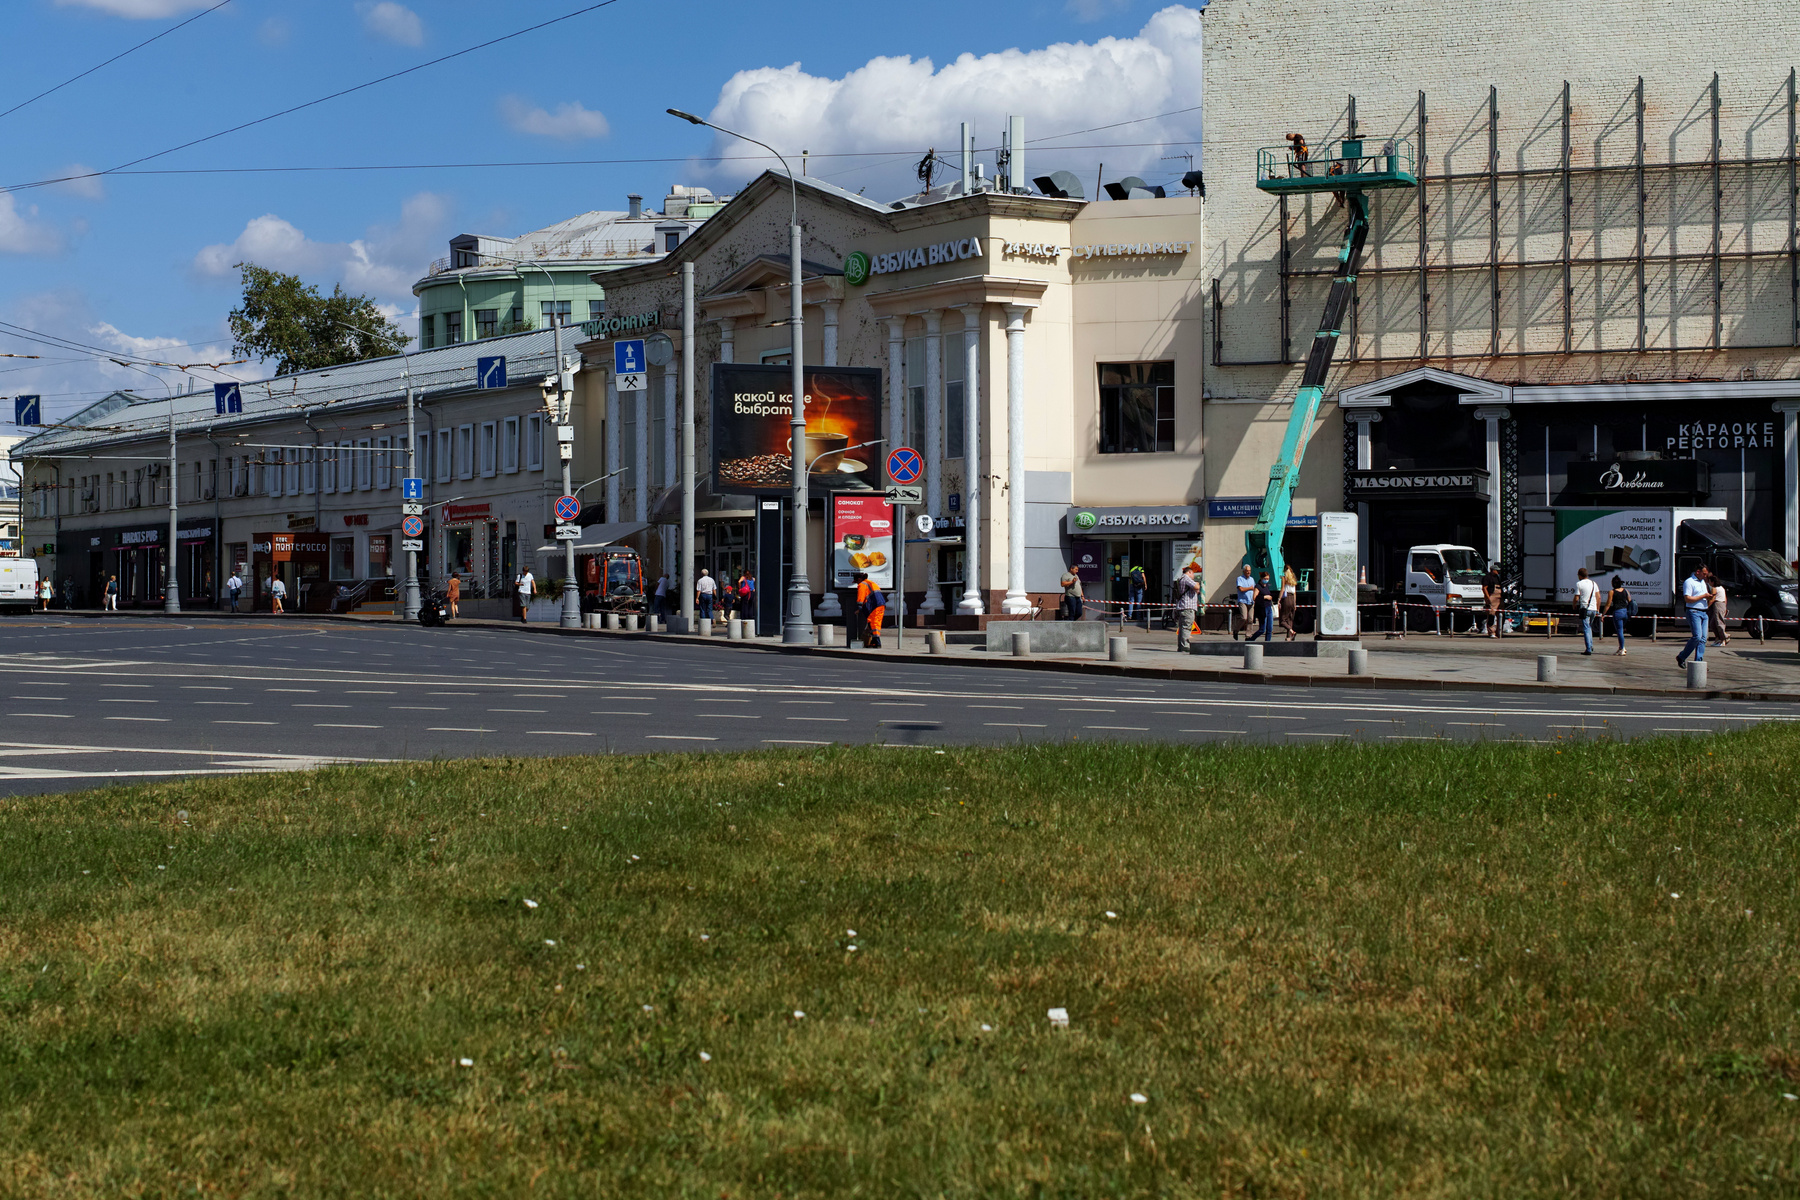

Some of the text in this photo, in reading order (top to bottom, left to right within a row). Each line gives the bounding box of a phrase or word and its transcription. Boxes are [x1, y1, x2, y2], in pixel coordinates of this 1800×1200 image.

[869, 237, 983, 276] АЗБУКА ВКУСА
[1005, 241, 1062, 257] 24 ЧАСА
[1072, 241, 1195, 259] СУПЕРМАРКЕТ
[580, 315, 638, 336] ЧАЙХОНА
[734, 391, 812, 404] какой кое
[734, 401, 806, 417] выбрат
[1679, 422, 1774, 437] КАРАОКЕ
[1667, 435, 1774, 449] РЕСТОРАН
[1353, 475, 1473, 488] MASONSTONE
[950, 497, 957, 506] 12
[1098, 513, 1189, 526] АЗБУКА ВКУСА
